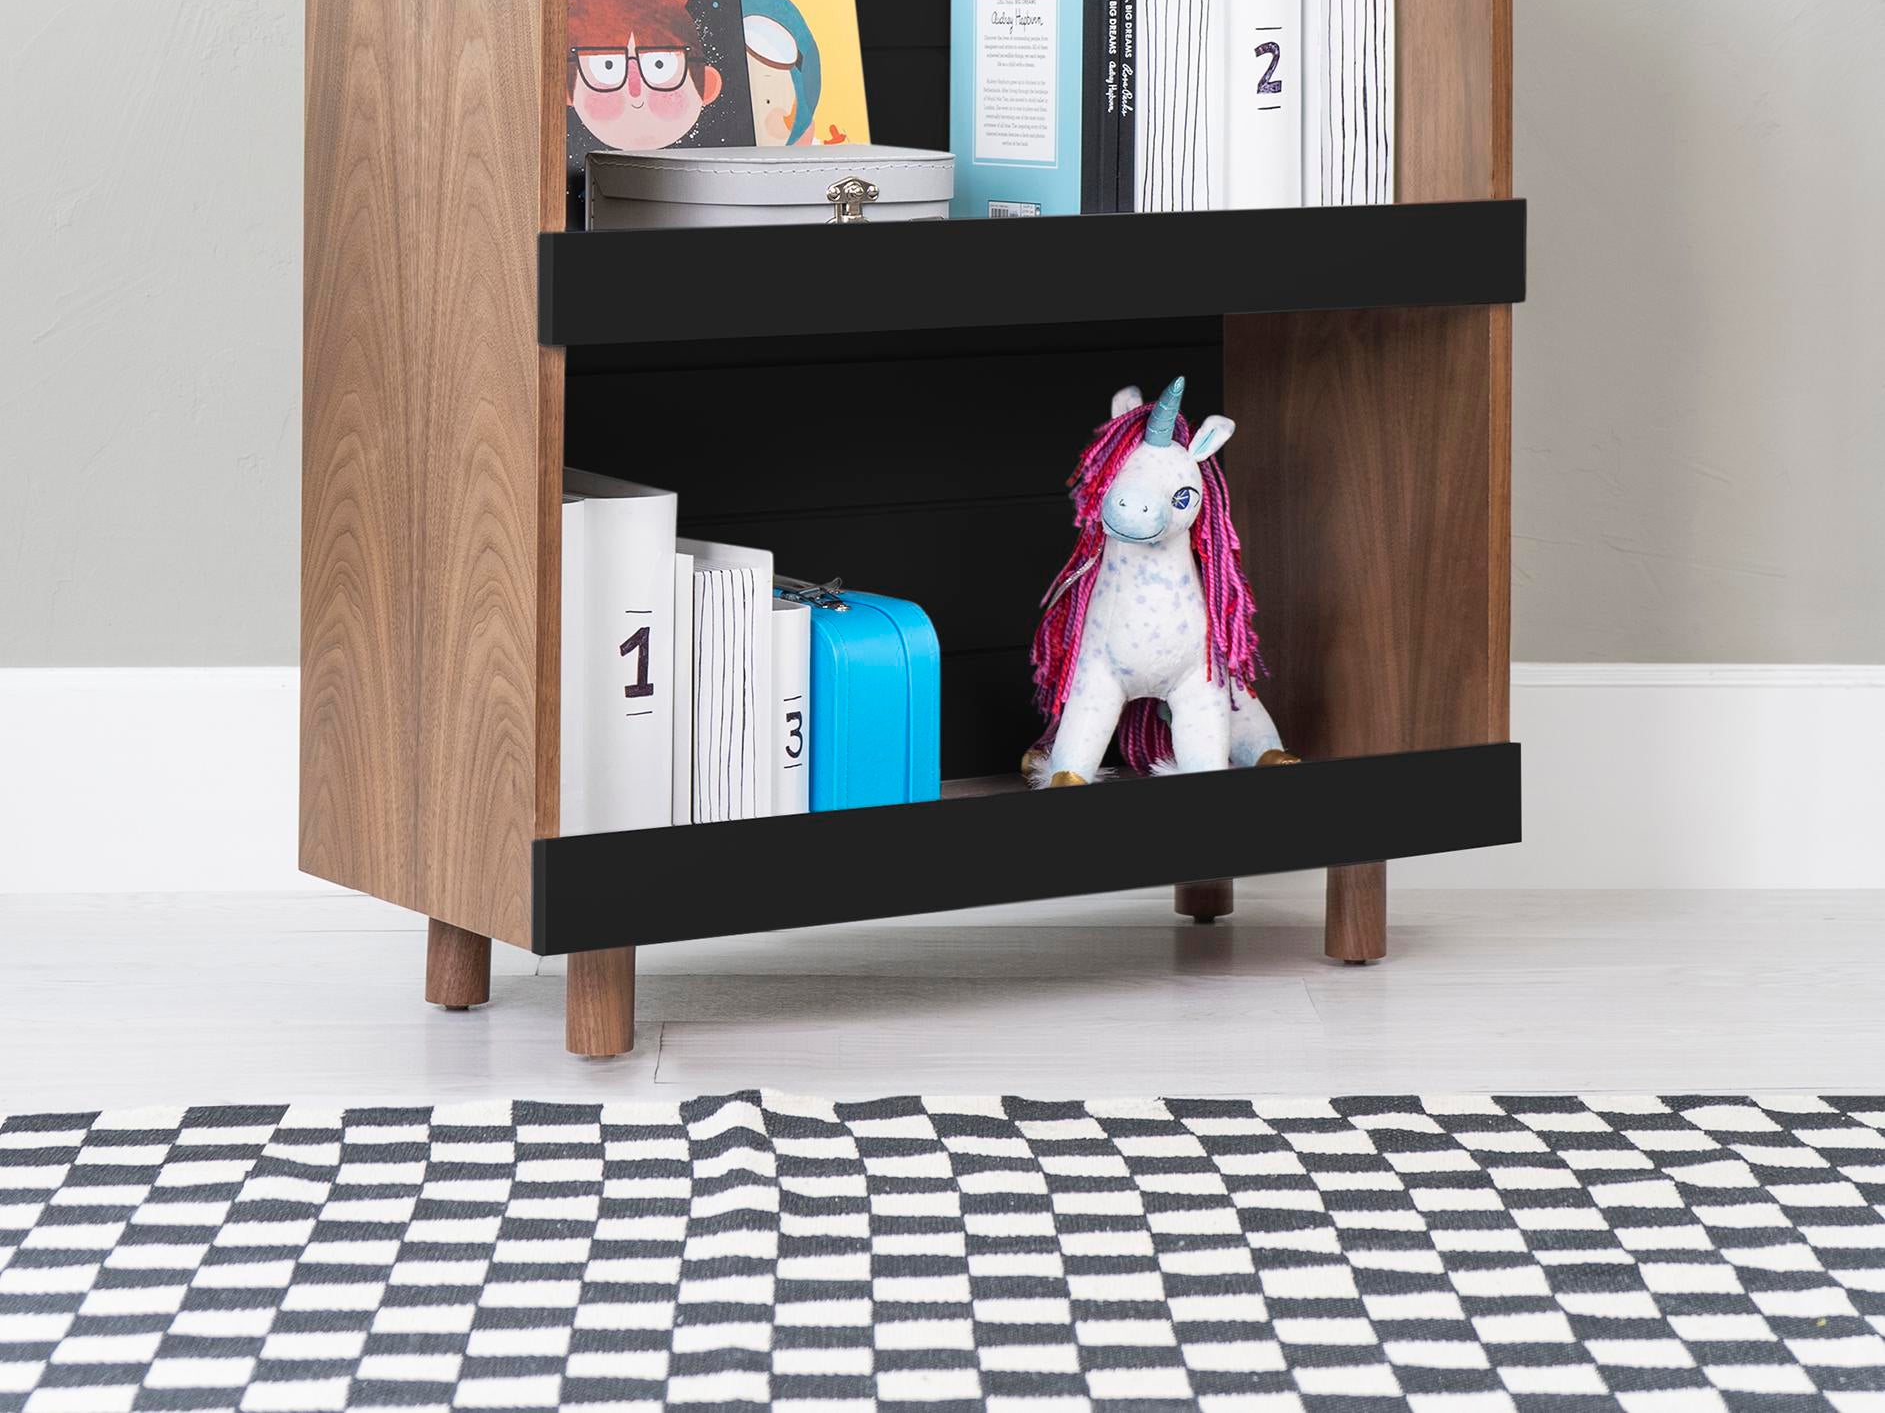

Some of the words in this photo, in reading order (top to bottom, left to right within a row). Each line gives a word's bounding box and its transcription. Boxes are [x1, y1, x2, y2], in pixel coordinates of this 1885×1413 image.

[1109, 1, 1117, 16] BIG
[1125, 5, 1133, 21] BIG
[1109, 18, 1117, 55] DREAMS
[1125, 22, 1133, 58] DREAMS
[1122, 64, 1134, 89] Rosa
[1254, 41, 1282, 94] 2
[619, 626, 654, 698] 1
[785, 711, 803, 758] 3
